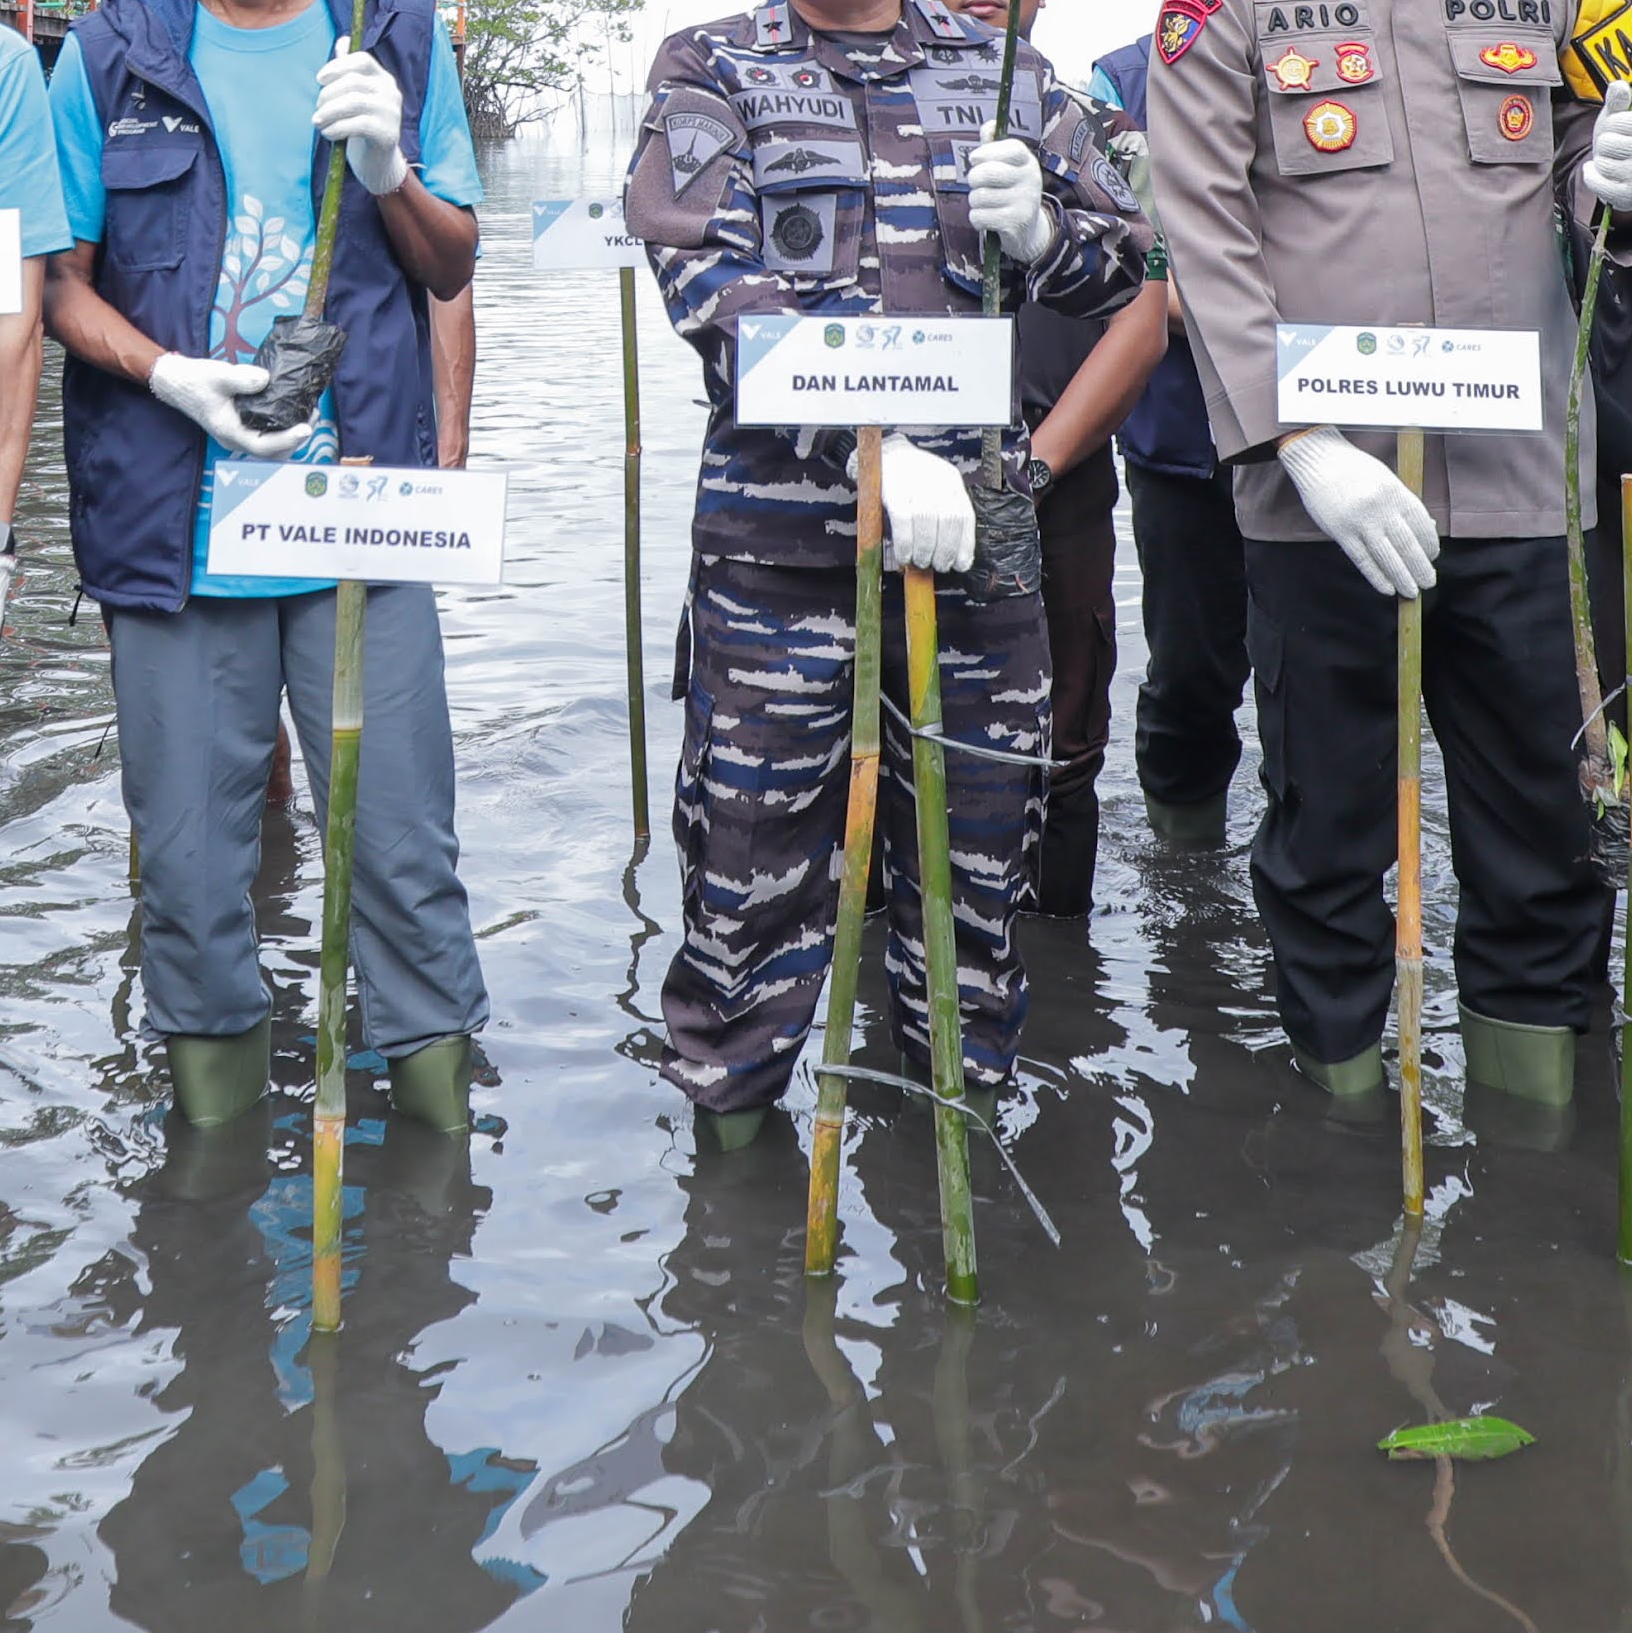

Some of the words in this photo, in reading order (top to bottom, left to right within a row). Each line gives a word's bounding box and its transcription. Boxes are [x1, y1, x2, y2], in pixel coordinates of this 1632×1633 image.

[1268, 2, 1359, 32] ARIO
[737, 95, 846, 122] WAHYUDI
[937, 106, 985, 125] TNI
[180, 124, 199, 133] VALE
[927, 334, 953, 342] CARES
[1456, 343, 1482, 352] CARES
[792, 375, 836, 392] DAN
[844, 375, 959, 392] LANTAMAL
[1298, 378, 1378, 395] POLRES
[1385, 380, 1445, 397] LUWU
[1453, 383, 1521, 399] TIMUR
[415, 485, 443, 495] CARES
[241, 524, 271, 541] PT
[279, 525, 337, 544] VALE
[345, 528, 472, 549] INDONESIA
